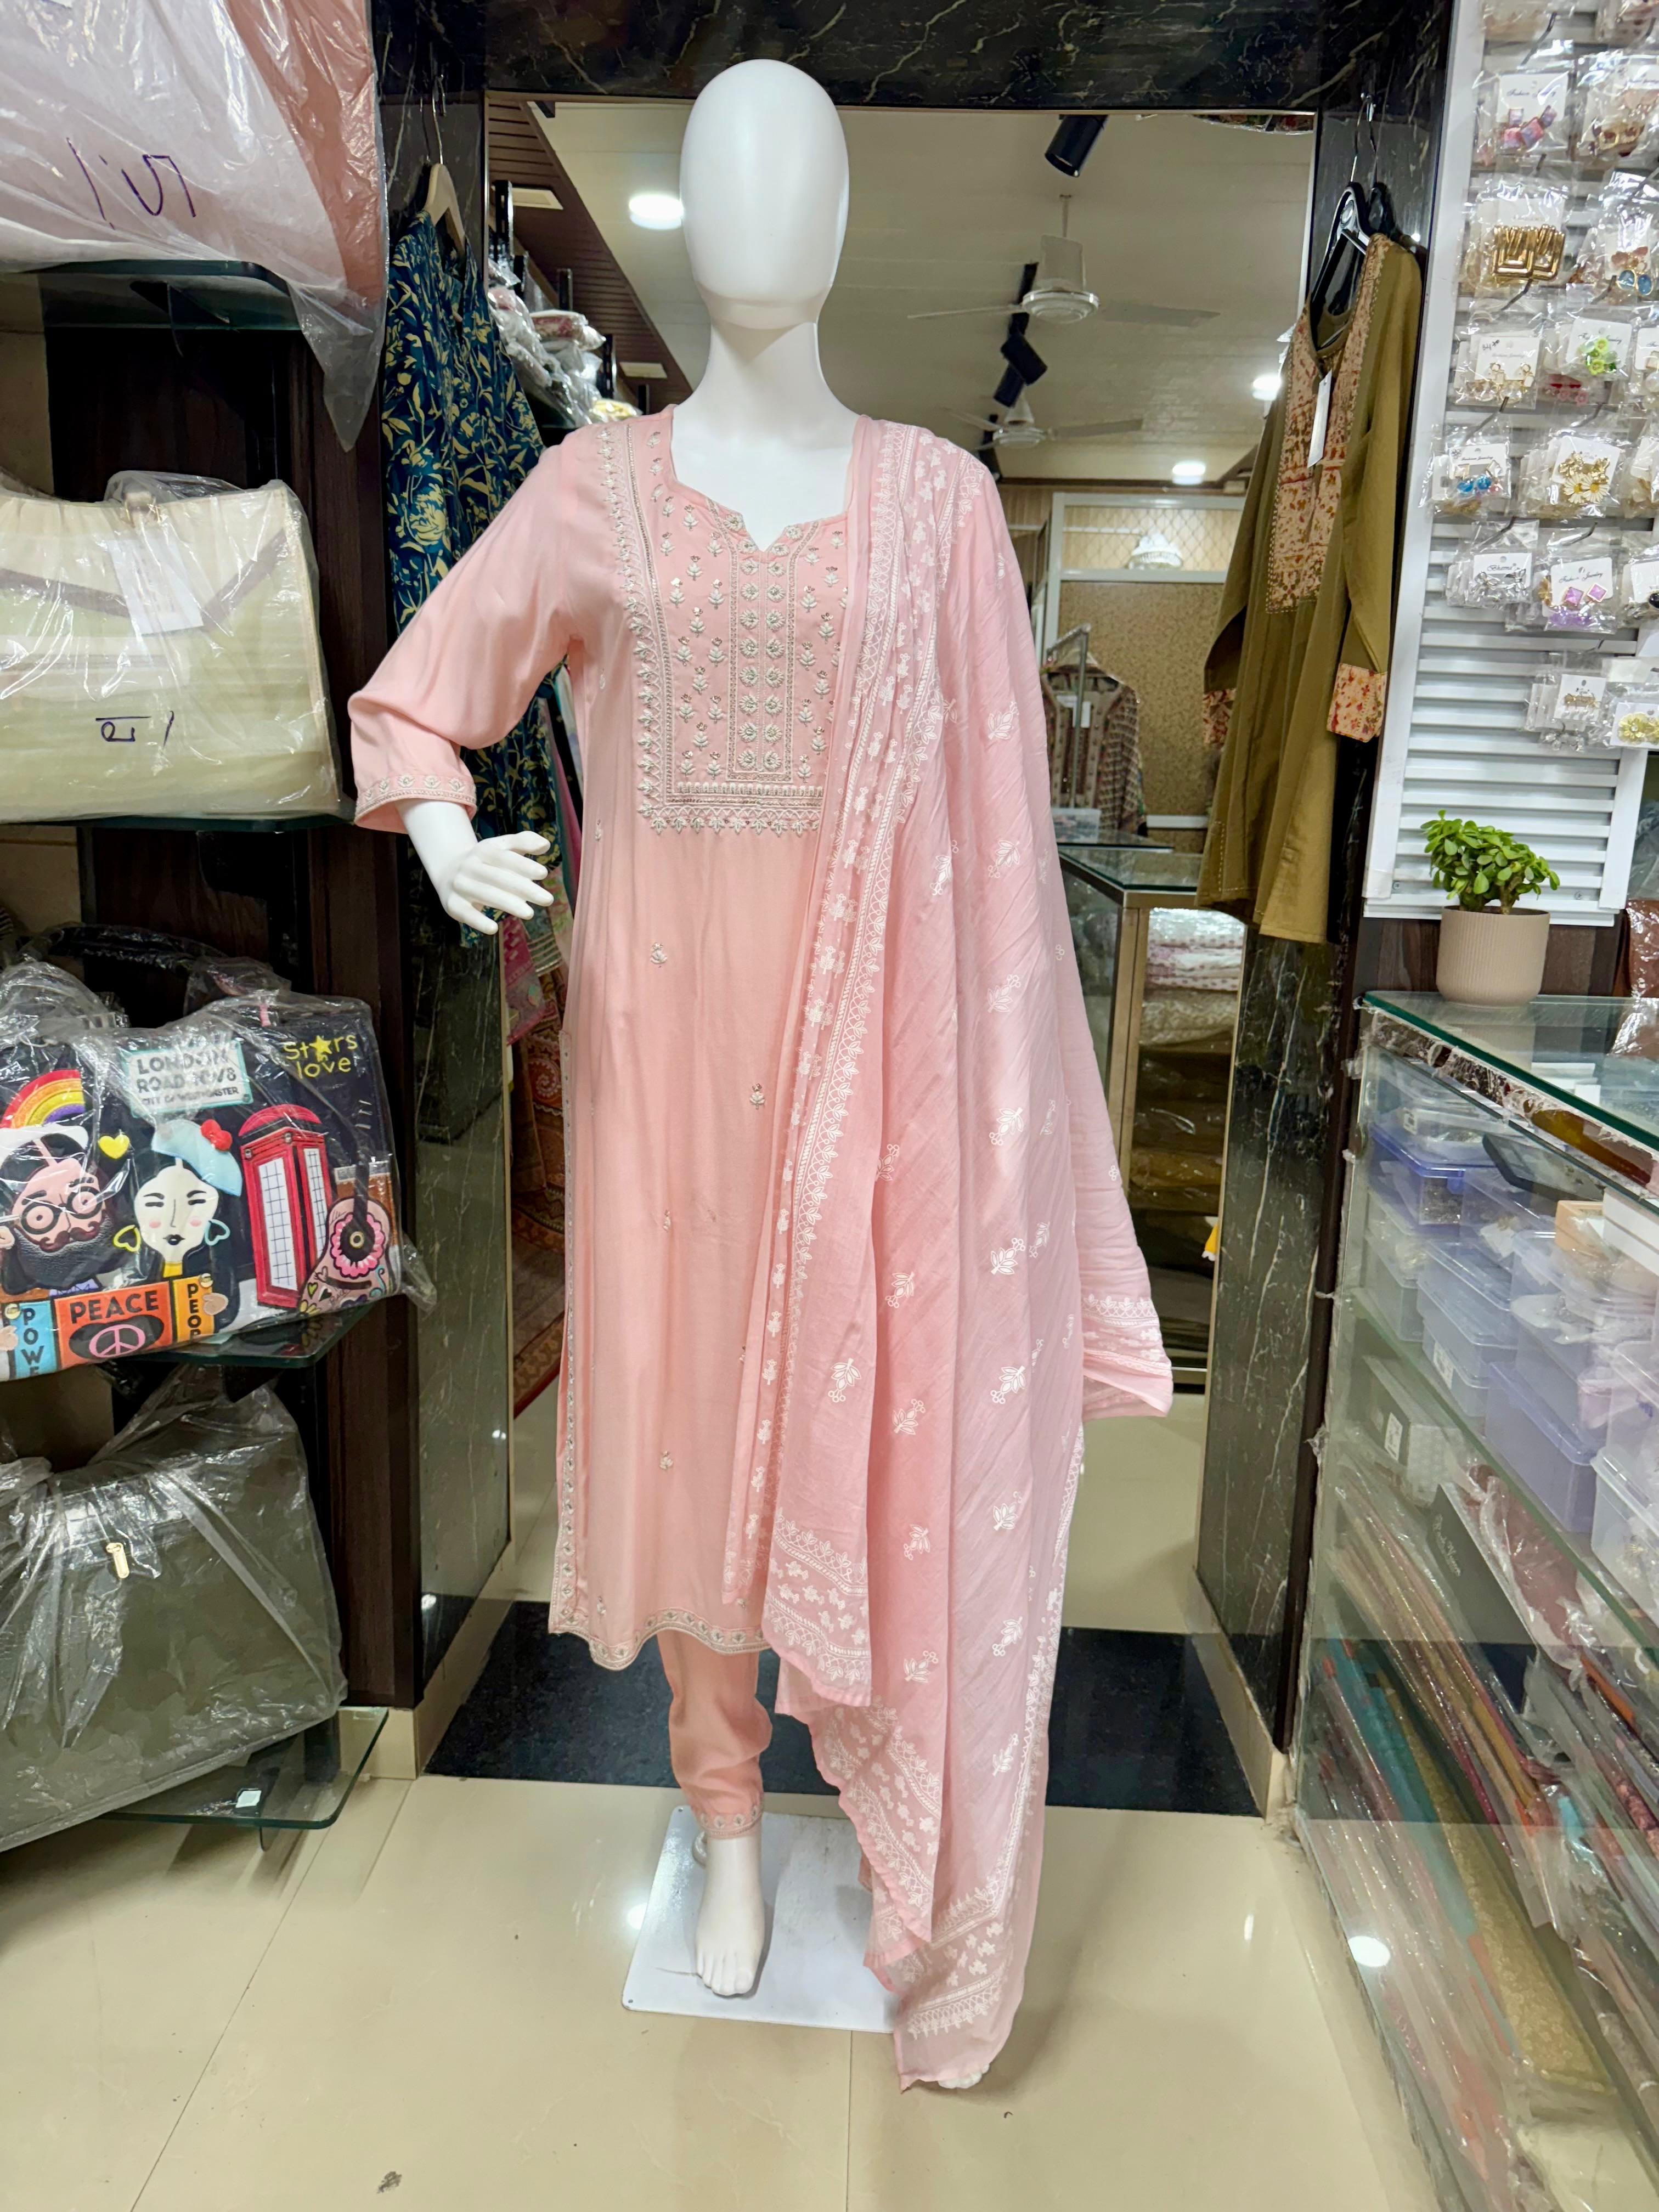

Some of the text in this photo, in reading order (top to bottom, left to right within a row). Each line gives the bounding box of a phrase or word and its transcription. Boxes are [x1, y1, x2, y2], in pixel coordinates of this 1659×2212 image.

[284, 1035, 358, 1060] Strs
[296, 1057, 352, 1079] love
[69, 1290, 159, 1324] PEACE
